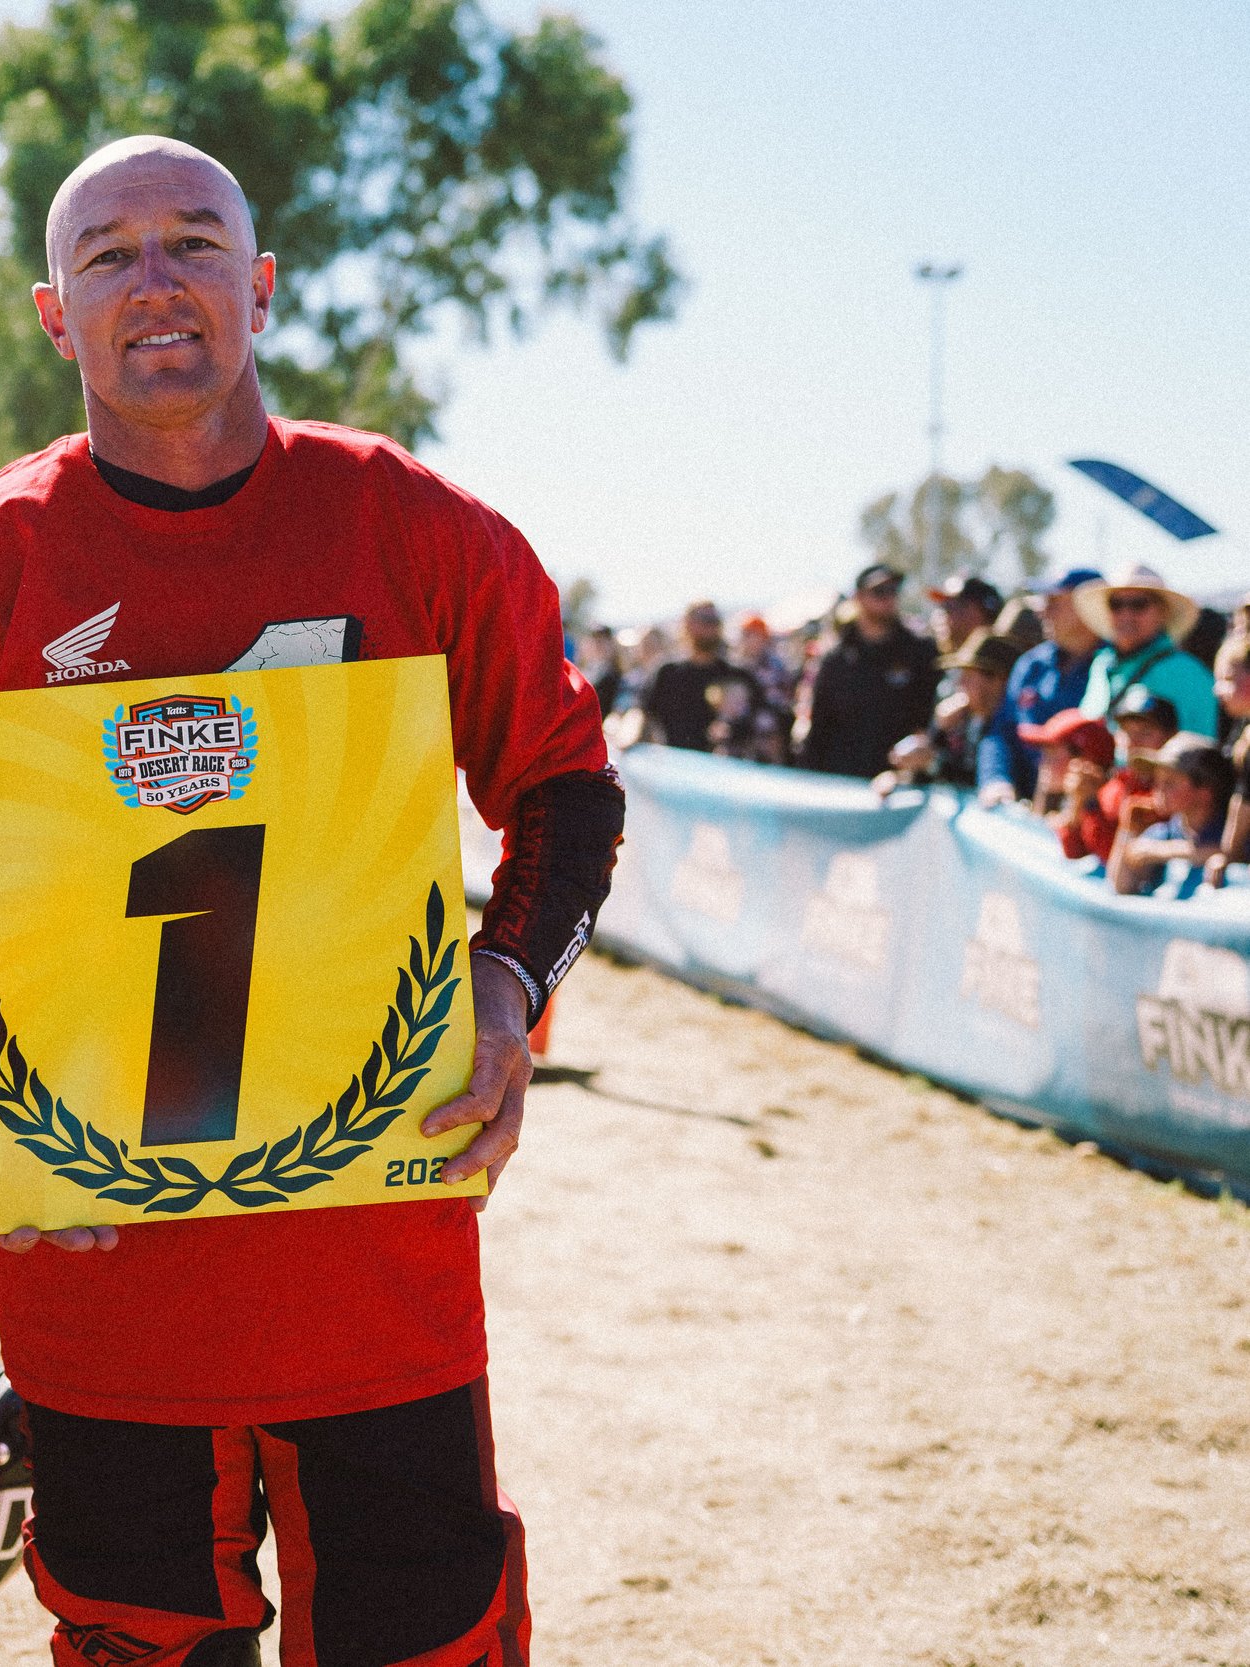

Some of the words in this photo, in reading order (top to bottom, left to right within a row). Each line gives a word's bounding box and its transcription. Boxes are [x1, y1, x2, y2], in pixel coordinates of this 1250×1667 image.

[45, 659, 131, 684] HONDA
[165, 706, 188, 716] Tatts
[123, 721, 236, 752] FINKE
[117, 769, 133, 778] 1976
[138, 755, 189, 779] DESERT
[191, 755, 226, 773] RACE
[146, 792, 164, 802] 50
[167, 777, 221, 799] YEARS
[125, 823, 266, 1148] 1
[384, 1156, 468, 1187] 202
